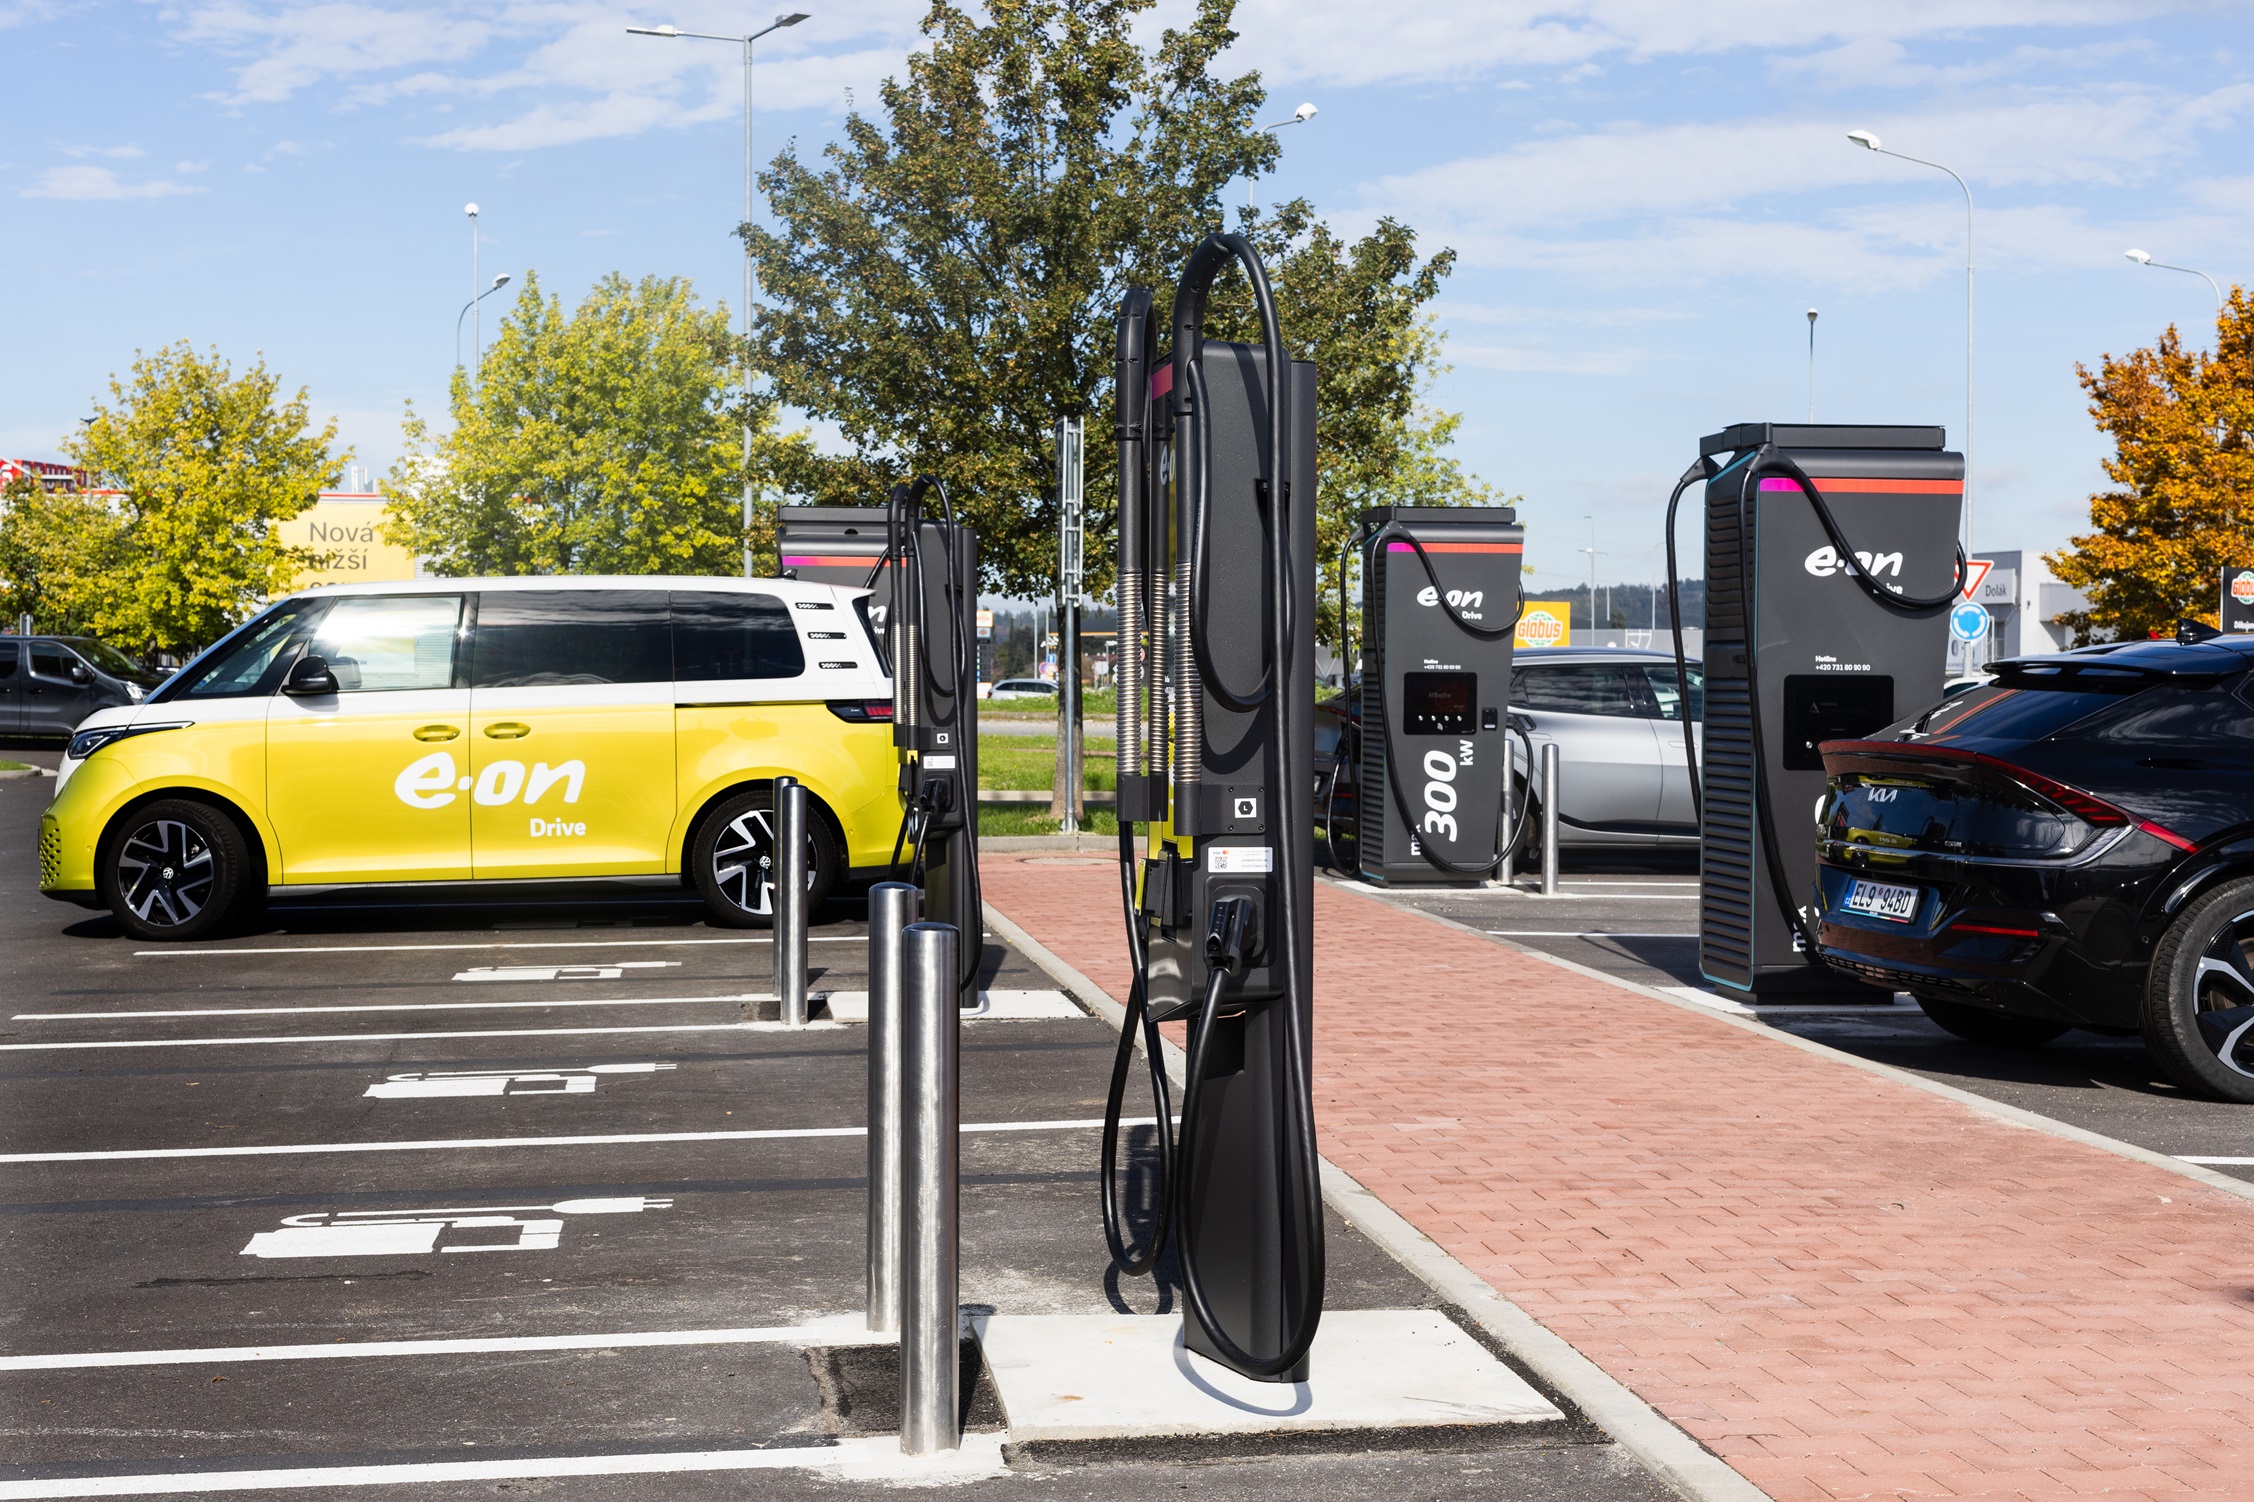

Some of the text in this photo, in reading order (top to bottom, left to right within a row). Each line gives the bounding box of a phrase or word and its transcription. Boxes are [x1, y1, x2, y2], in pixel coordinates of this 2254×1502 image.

[309, 521, 373, 543] Nová
[1985, 584, 2007, 598] Dolák
[1461, 610, 1483, 621] Drive
[1516, 618, 1562, 639] Globus
[1815, 655, 1837, 663] Hotline
[1815, 663, 1871, 671] +420 731 80 90 90
[1459, 739, 1474, 766] kW
[1423, 749, 1458, 842] 300
[530, 817, 586, 837] Drive
[1852, 883, 1911, 914] EL9 94BD
